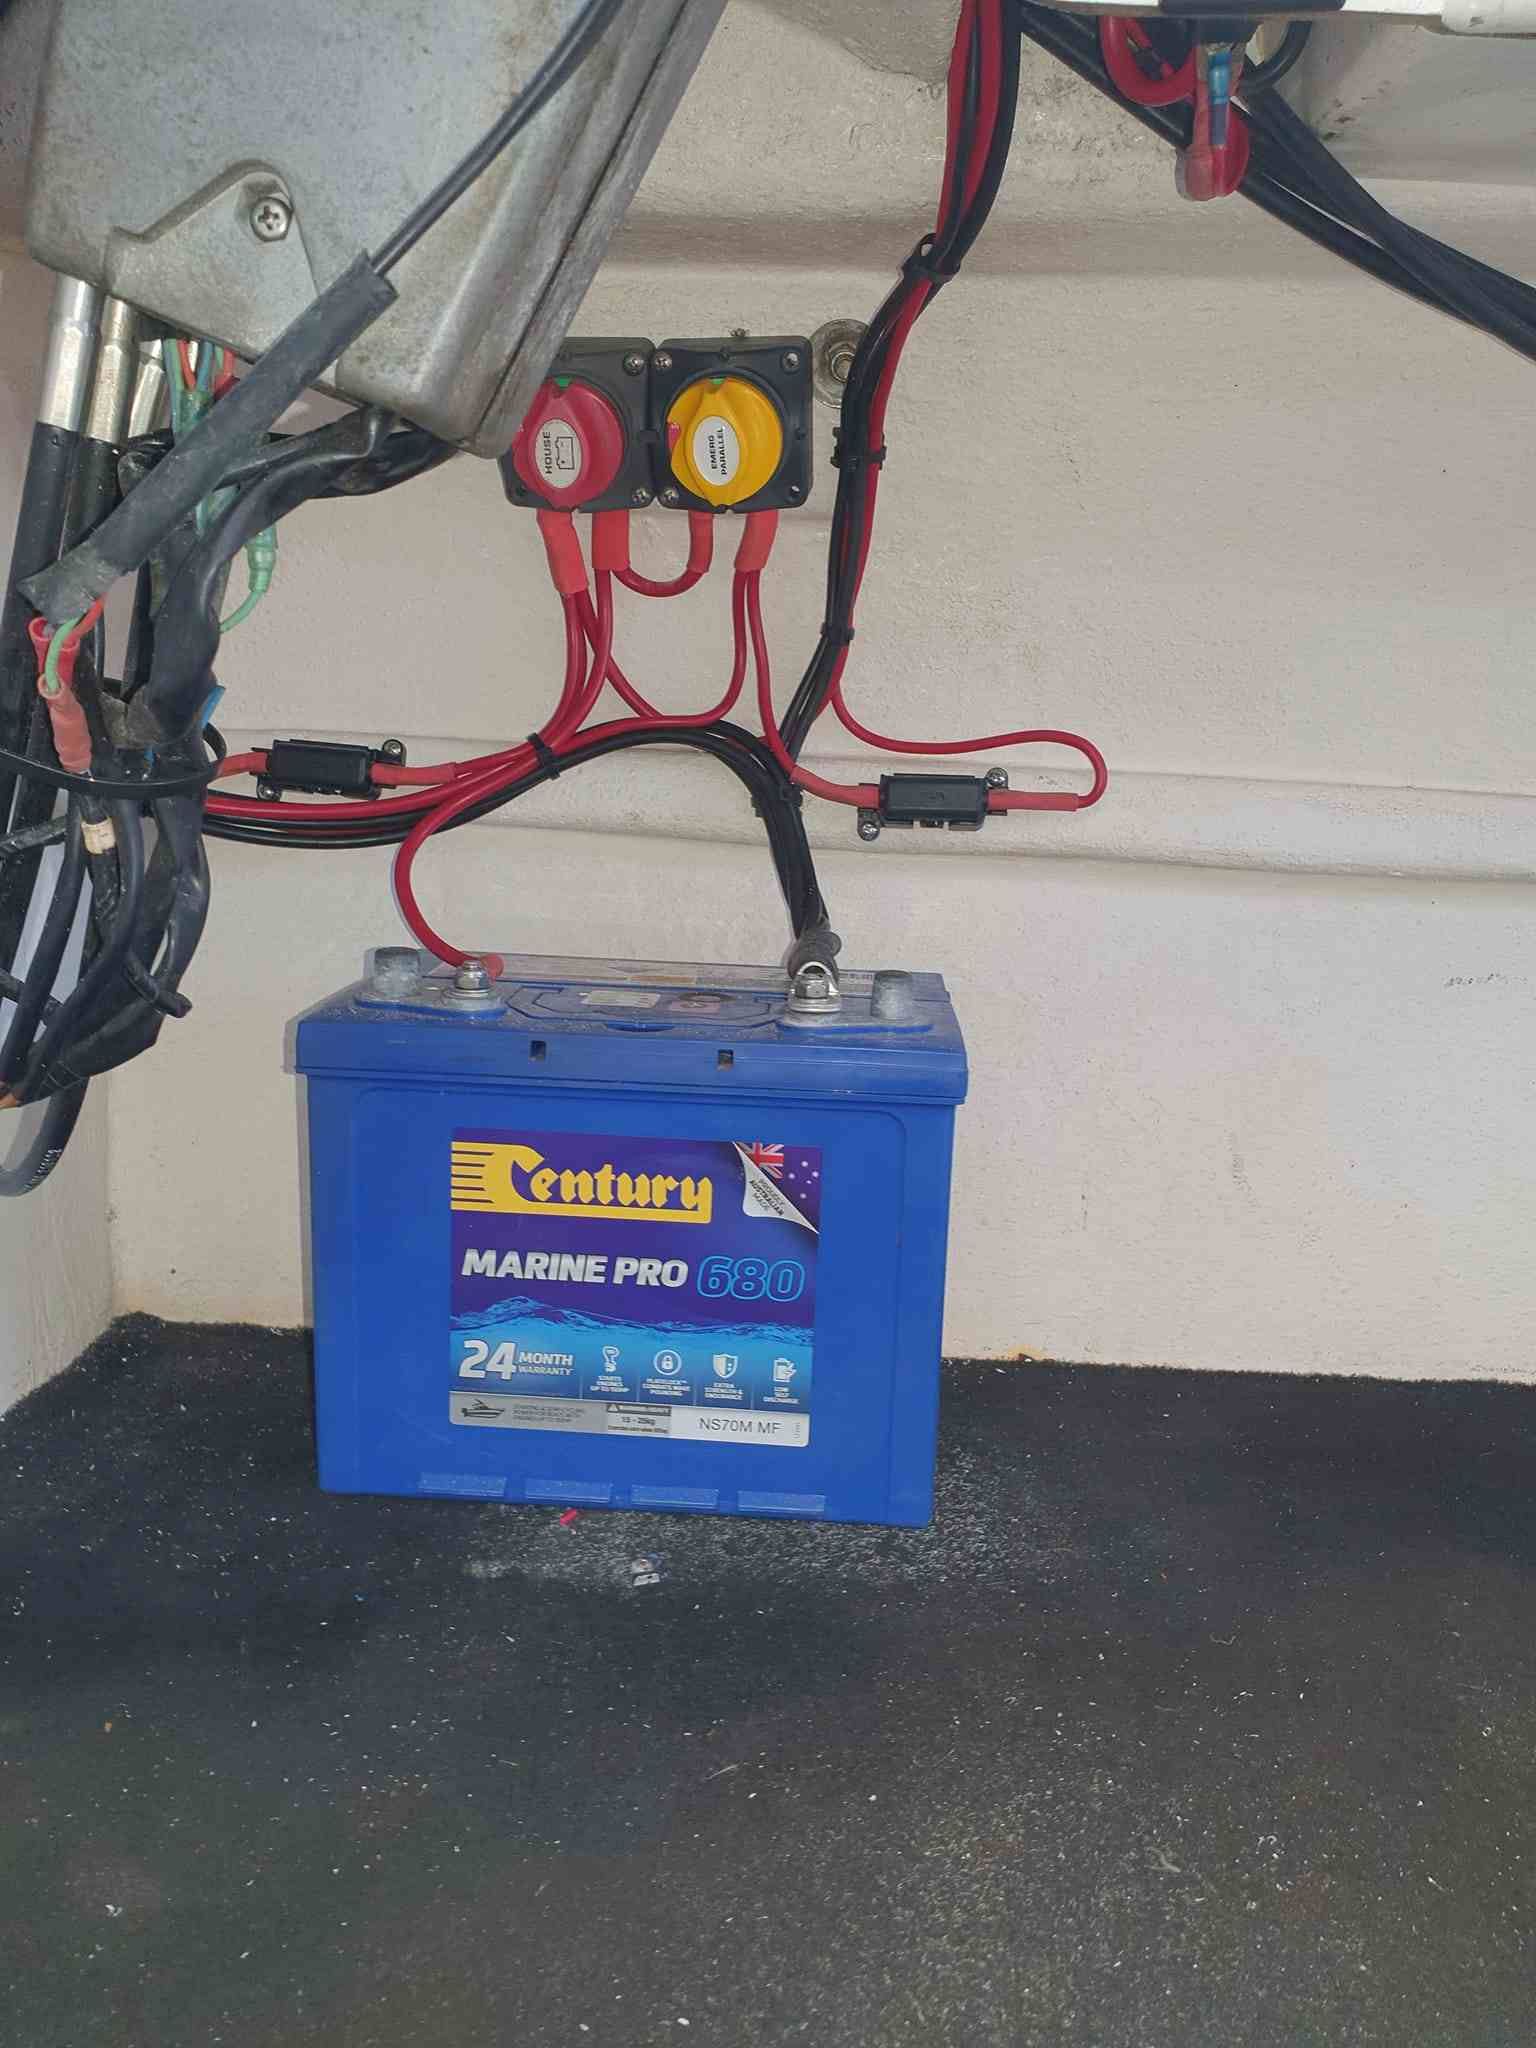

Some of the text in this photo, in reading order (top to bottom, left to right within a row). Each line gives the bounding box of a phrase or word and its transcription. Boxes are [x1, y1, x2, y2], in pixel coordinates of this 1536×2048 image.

[542, 431, 553, 475] HOUSE
[708, 434, 718, 470] EMERG
[718, 427, 728, 476] PARALLEL
[450, 1141, 713, 1224] Century
[461, 1248, 806, 1303] MARINE PRO 680
[458, 1339, 518, 1381] 24
[518, 1350, 574, 1367] MONTH
[518, 1366, 574, 1377] WARRANTY
[699, 1417, 753, 1433] NS70M
[757, 1421, 783, 1435] MF
